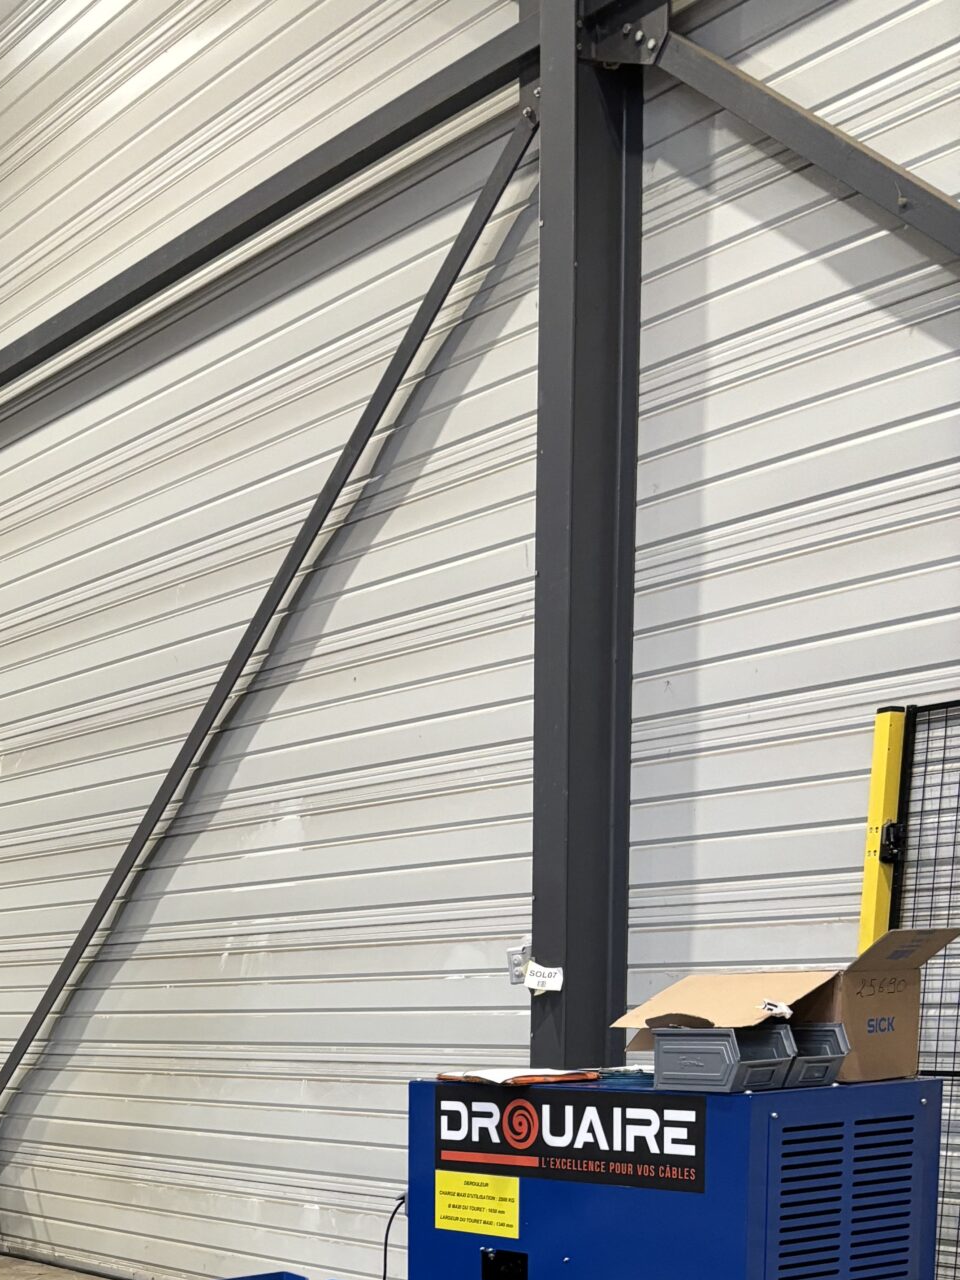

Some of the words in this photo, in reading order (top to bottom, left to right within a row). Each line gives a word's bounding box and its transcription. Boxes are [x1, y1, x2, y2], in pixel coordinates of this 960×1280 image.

[528, 969, 558, 979] SOL07
[867, 1015, 895, 1034] SICK
[440, 1098, 696, 1157] DROUAIRE
[541, 1157, 606, 1173] L'EXCELLENCE
[609, 1162, 634, 1175] POUR
[637, 1164, 655, 1177] VOS
[658, 1164, 696, 1180] CÂBLES
